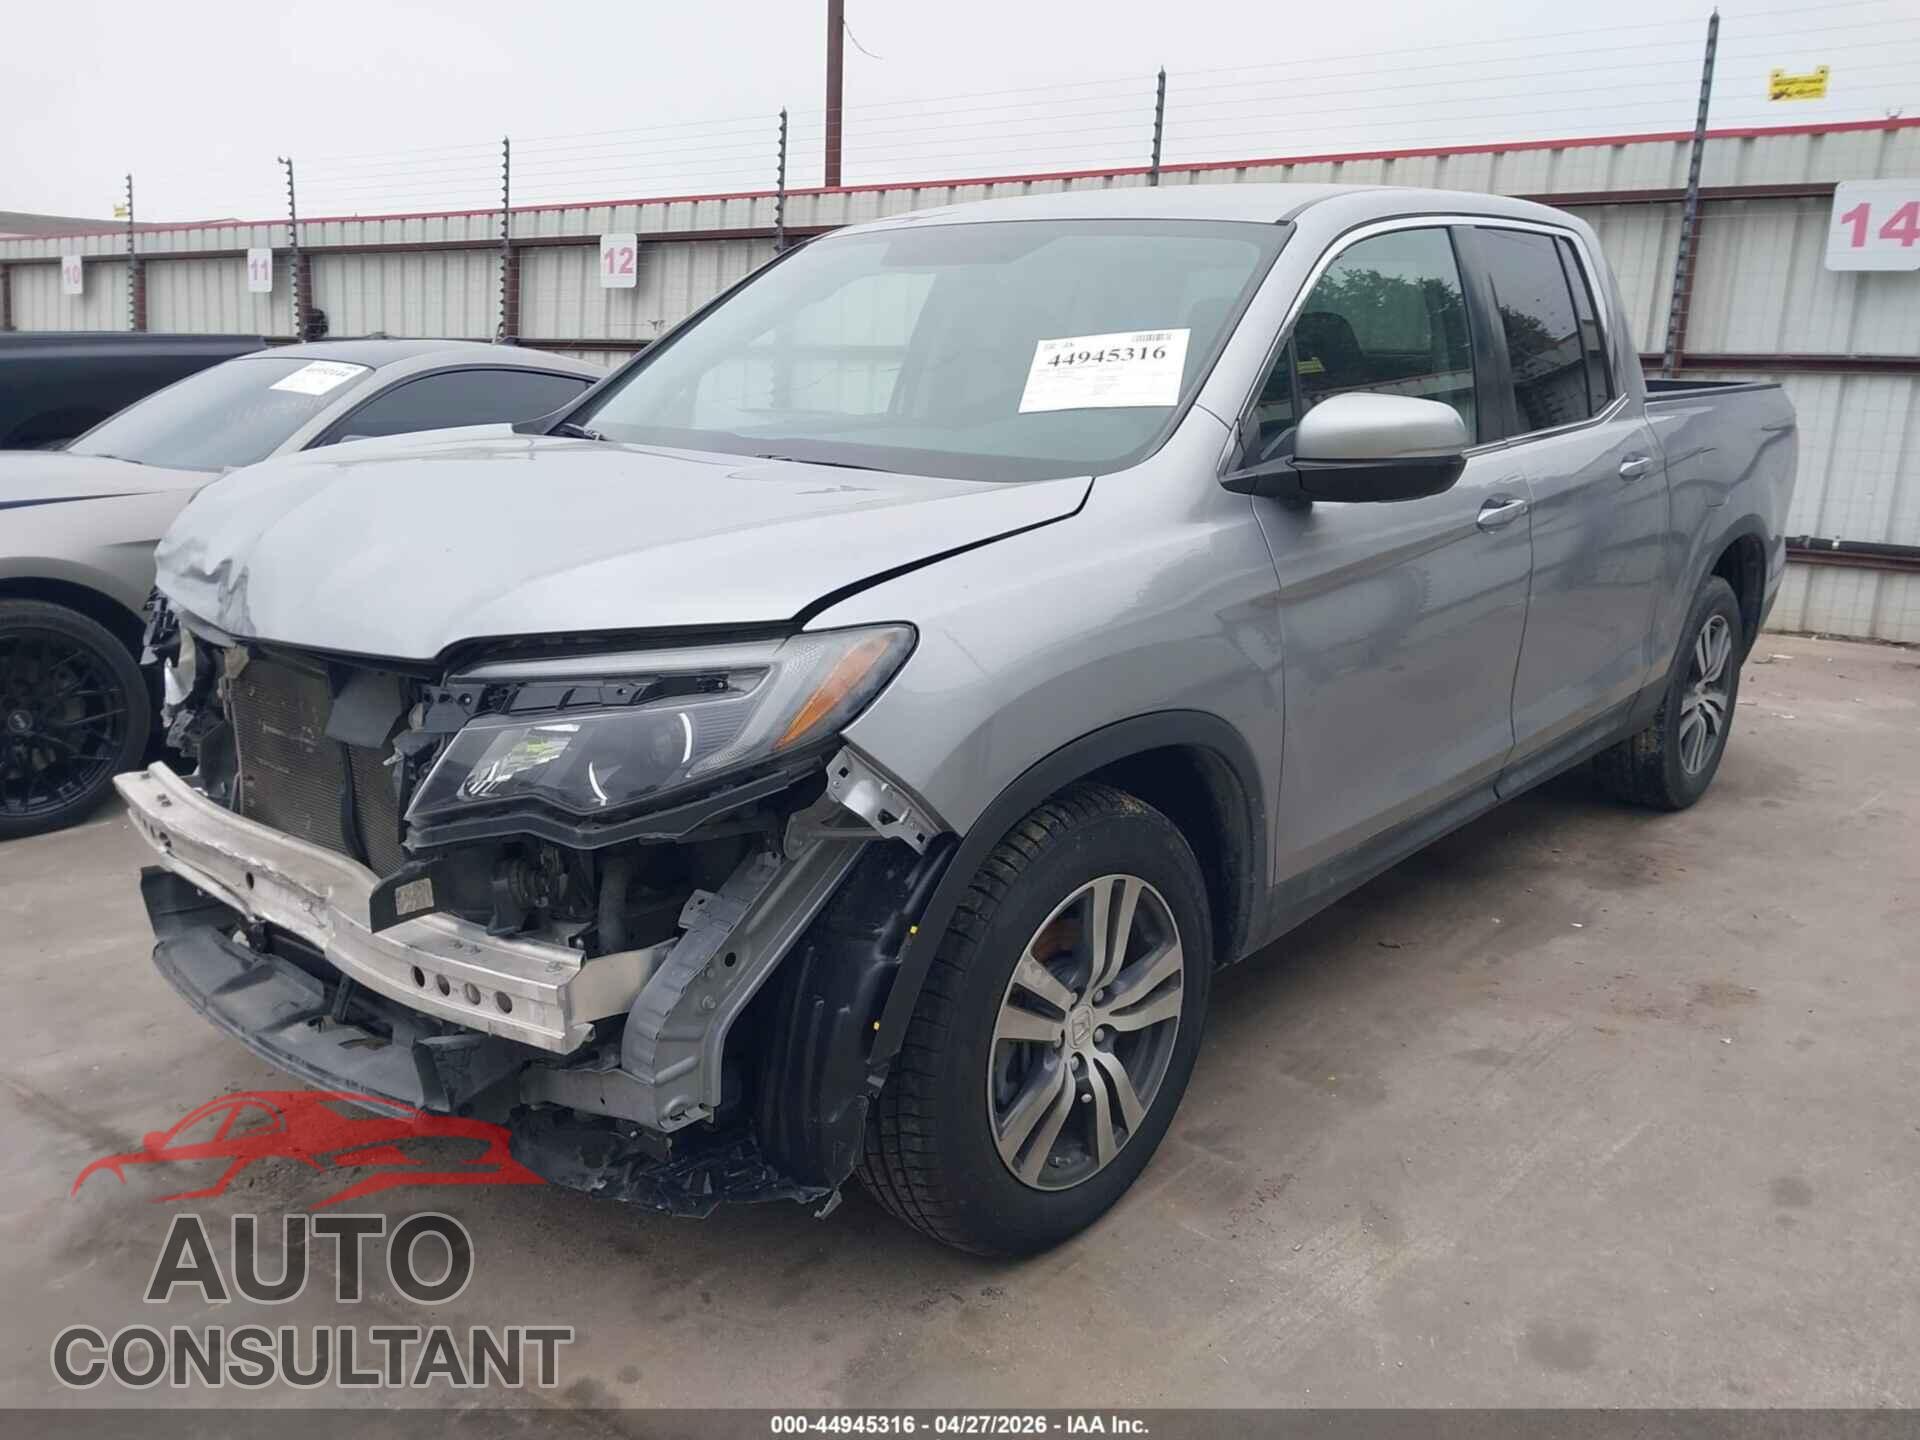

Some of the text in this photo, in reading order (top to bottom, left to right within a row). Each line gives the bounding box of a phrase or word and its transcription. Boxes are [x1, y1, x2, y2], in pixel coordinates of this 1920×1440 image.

[1841, 202, 1920, 248] 14
[251, 259, 269, 281] 11
[604, 248, 633, 274] 12
[64, 266, 80, 284] 10
[1048, 346, 1166, 367] 44945316
